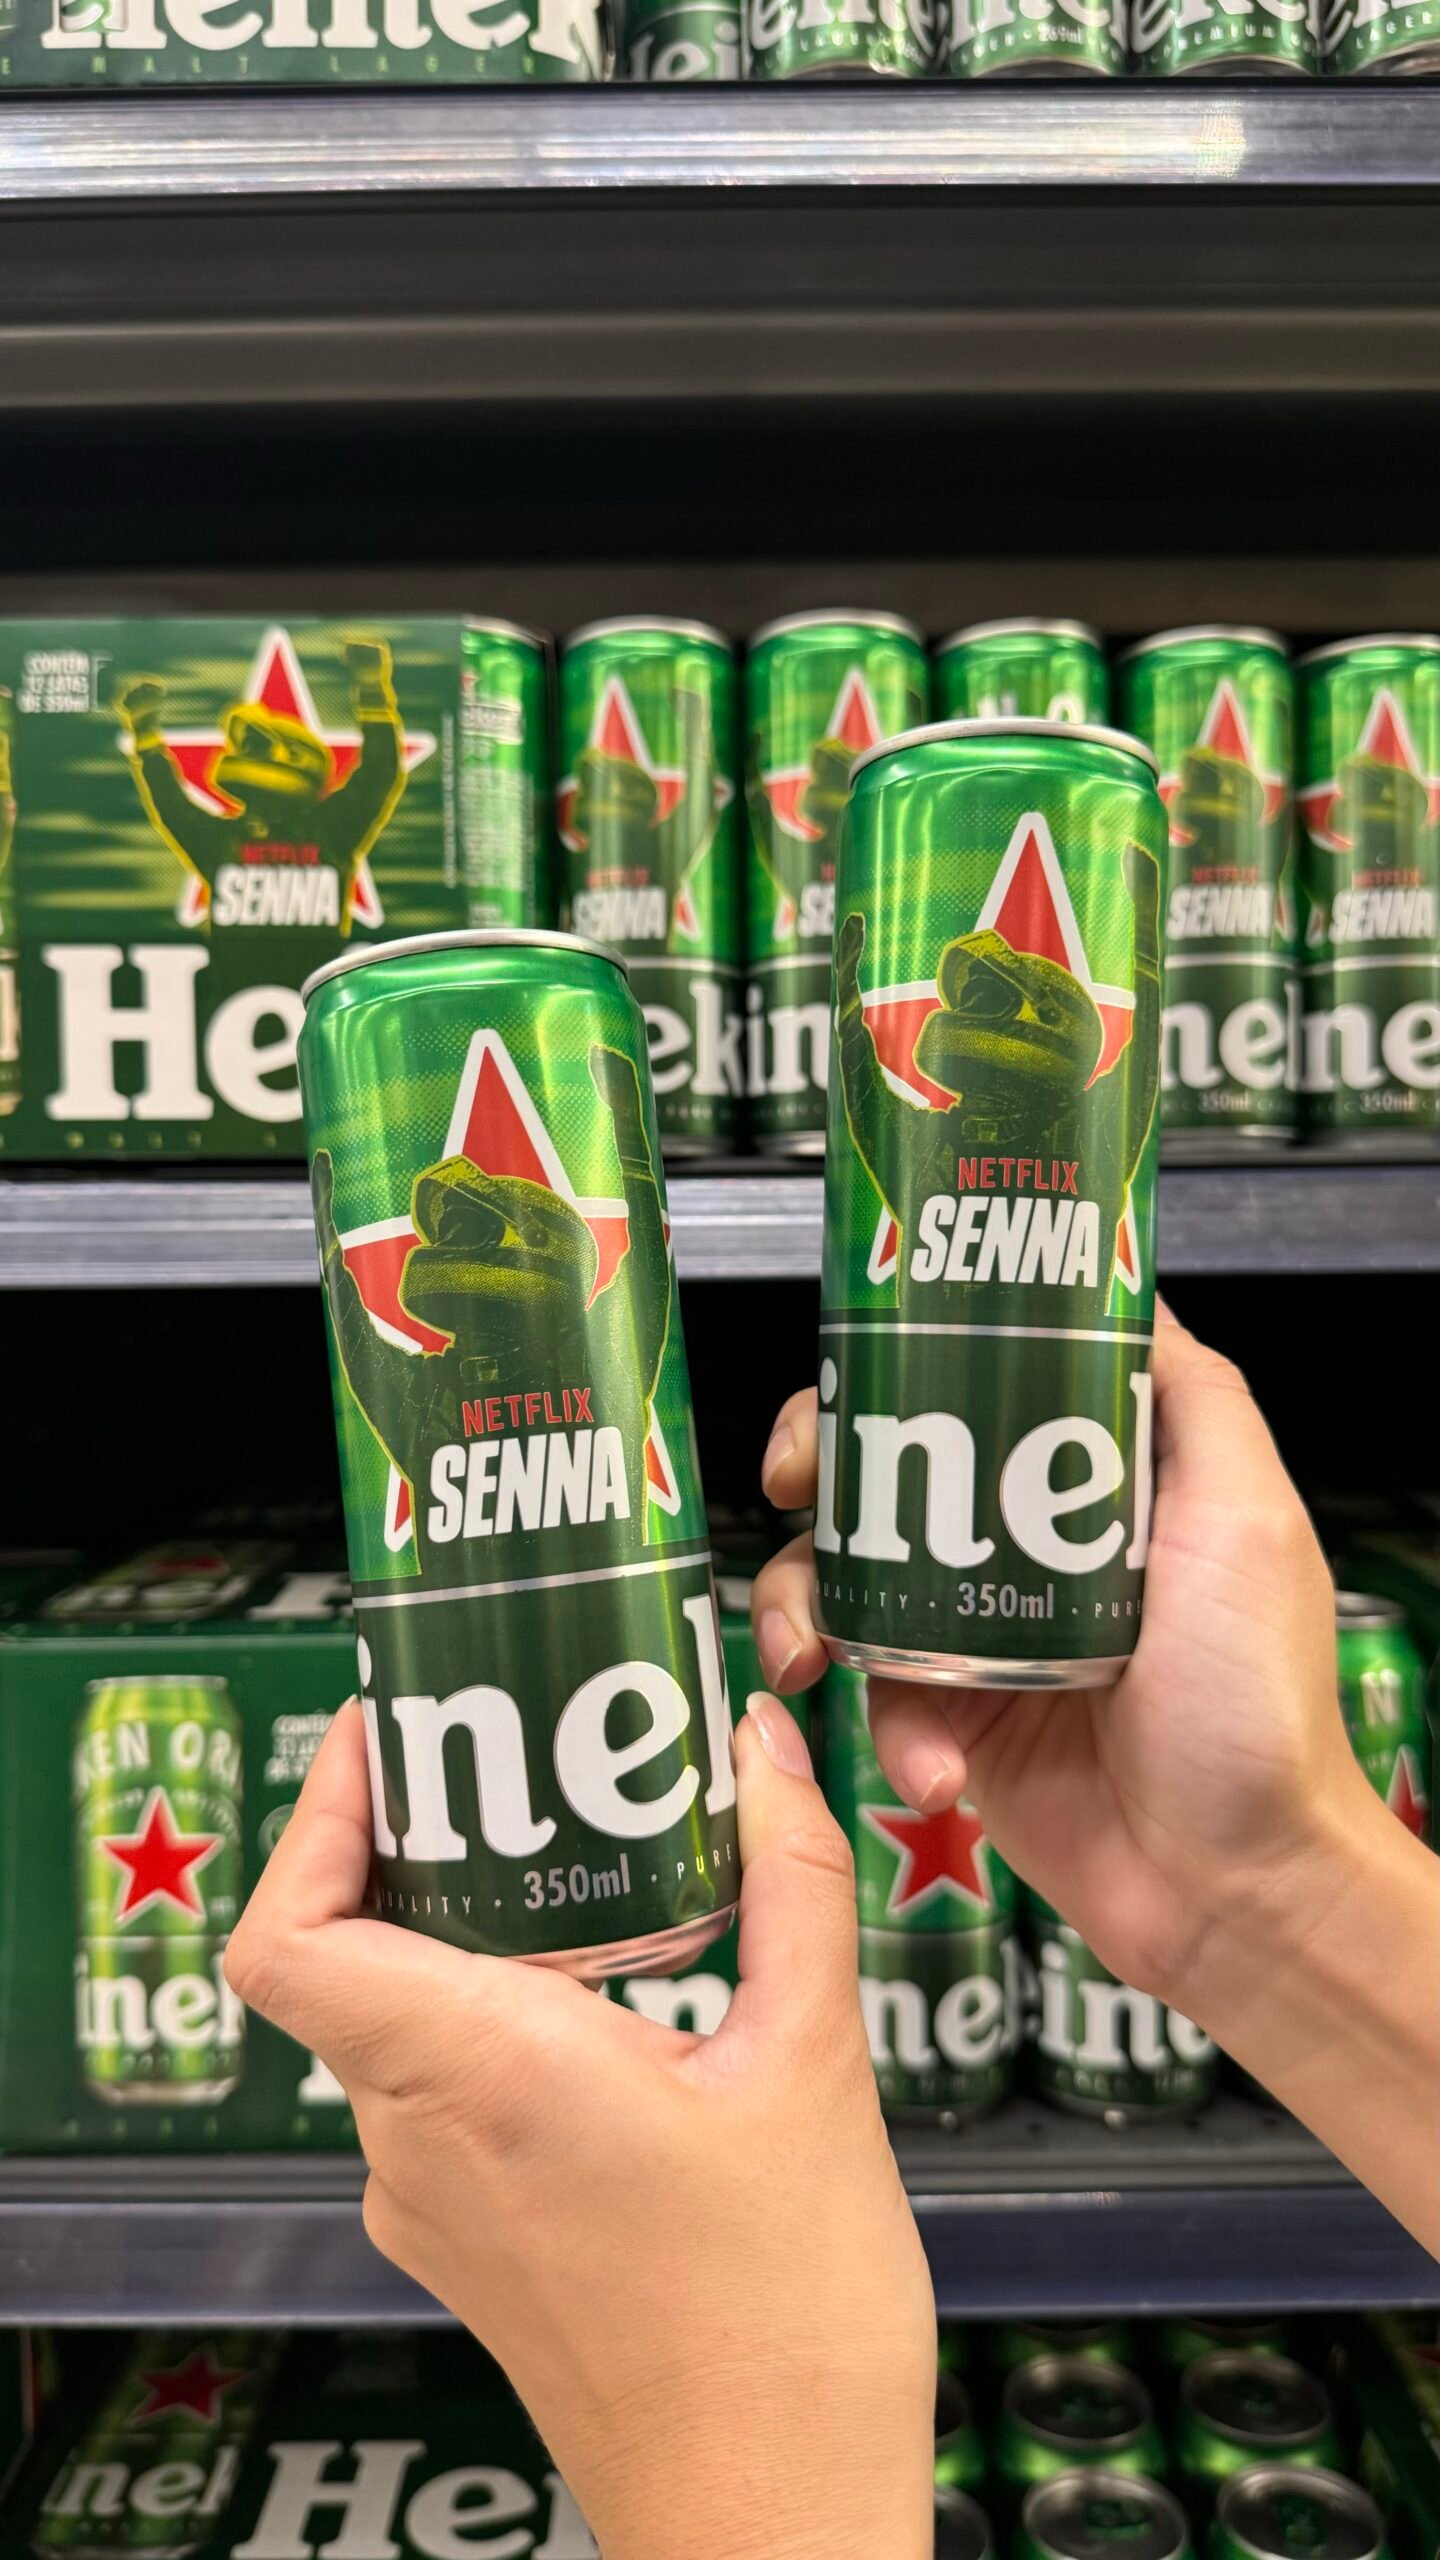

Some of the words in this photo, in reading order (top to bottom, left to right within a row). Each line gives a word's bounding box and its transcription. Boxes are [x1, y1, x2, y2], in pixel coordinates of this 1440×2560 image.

[213, 864, 340, 927] SENNA
[1165, 885, 1271, 940] SENNA
[1328, 886, 1435, 945] SENNA
[958, 1157, 1079, 1195] NETFLIX
[910, 1194, 1100, 1288] SENNA
[462, 1388, 595, 1437] NETFLIX
[427, 1426, 631, 1543] SENNA
[956, 1581, 1055, 1619] 350ml
[523, 1852, 631, 1910] 350ml
[676, 1843, 732, 1881] PURE
